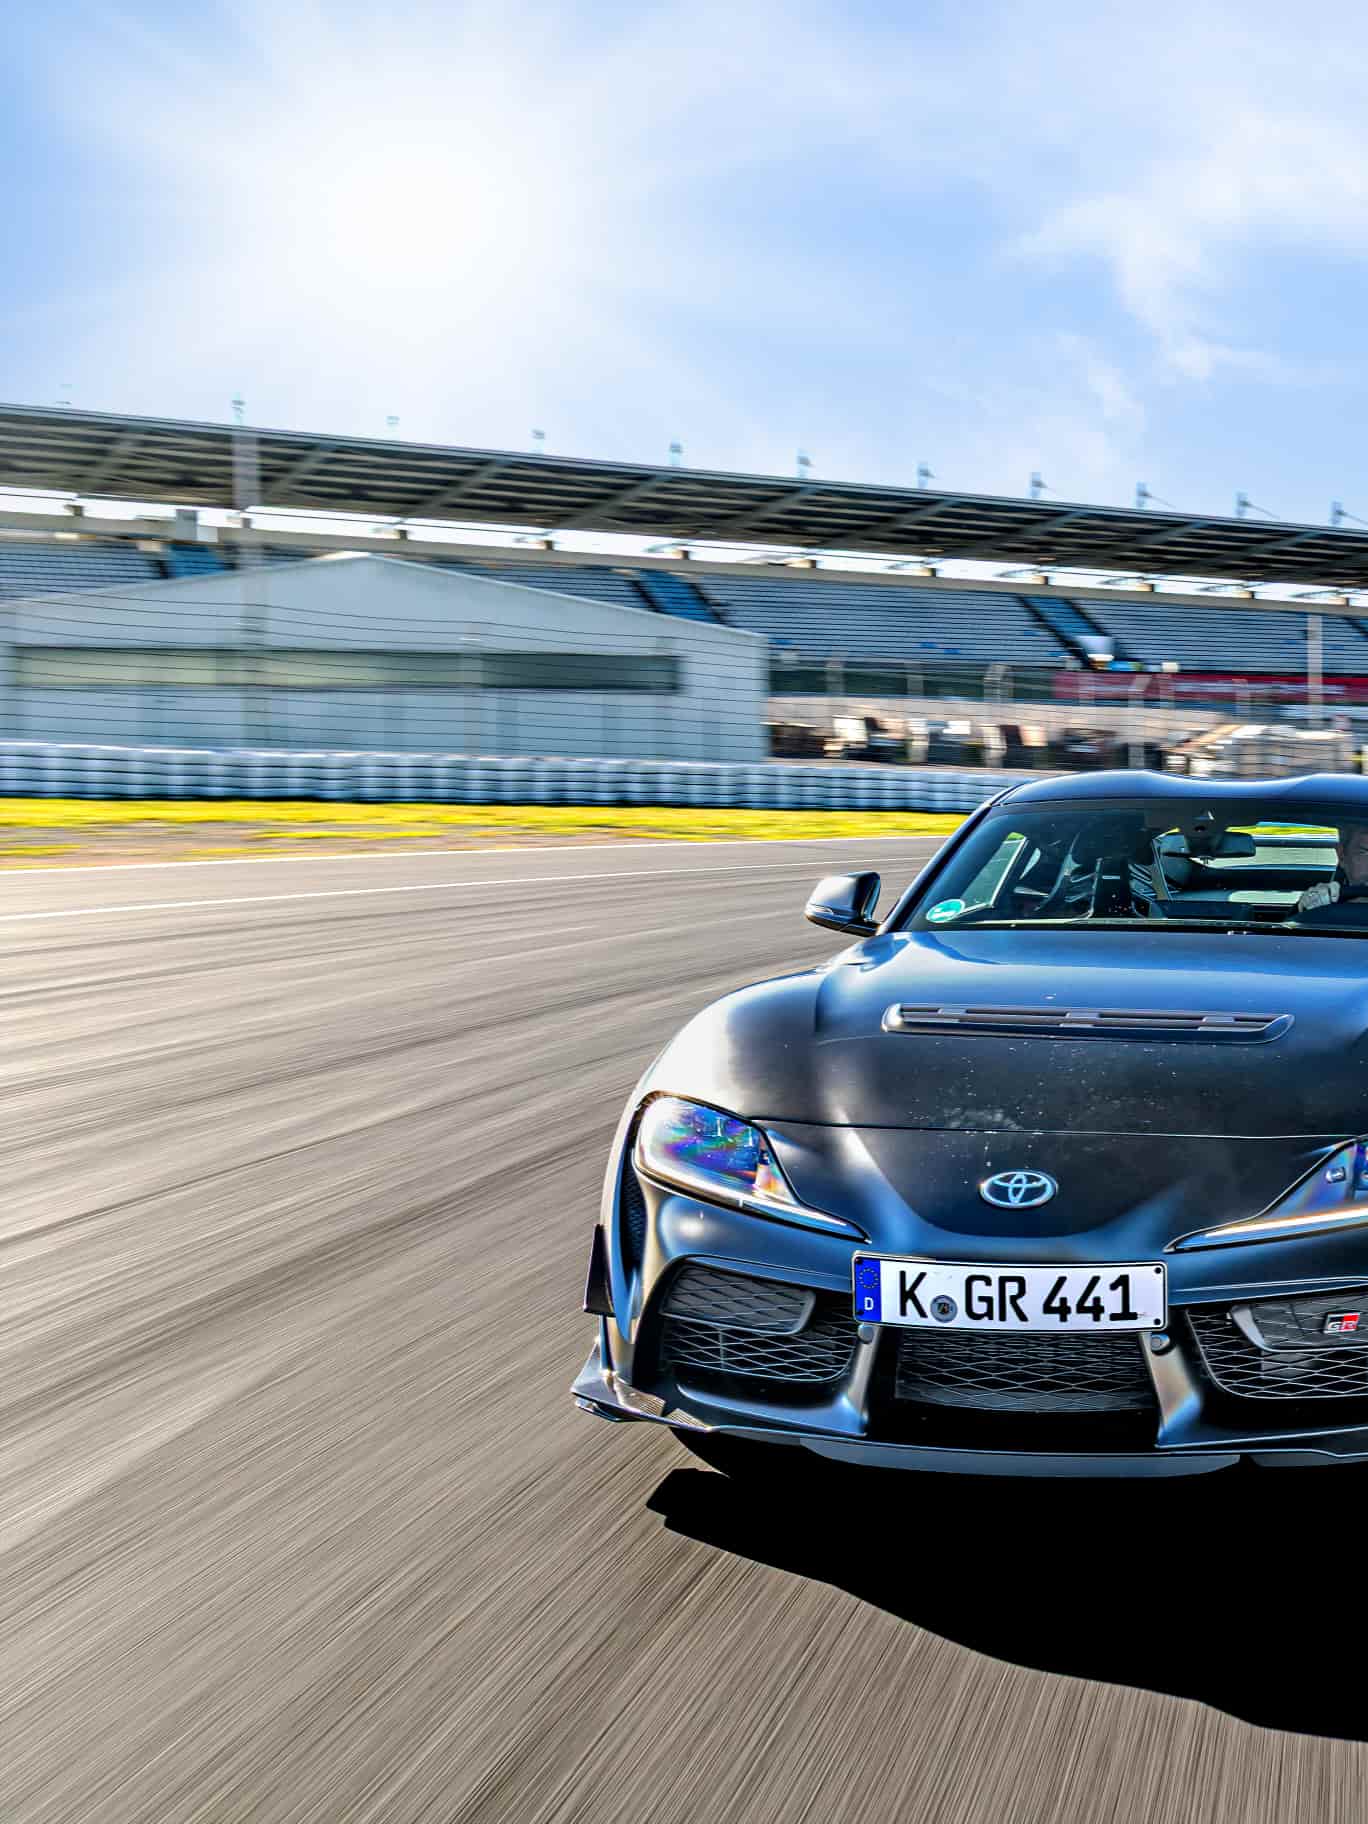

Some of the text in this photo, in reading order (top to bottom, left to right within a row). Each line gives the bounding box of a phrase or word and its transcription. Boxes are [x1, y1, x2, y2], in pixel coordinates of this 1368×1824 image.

[864, 1296, 874, 1311] D
[899, 1270, 1139, 1322] K GR 441
[1325, 1318, 1359, 1332] GR
